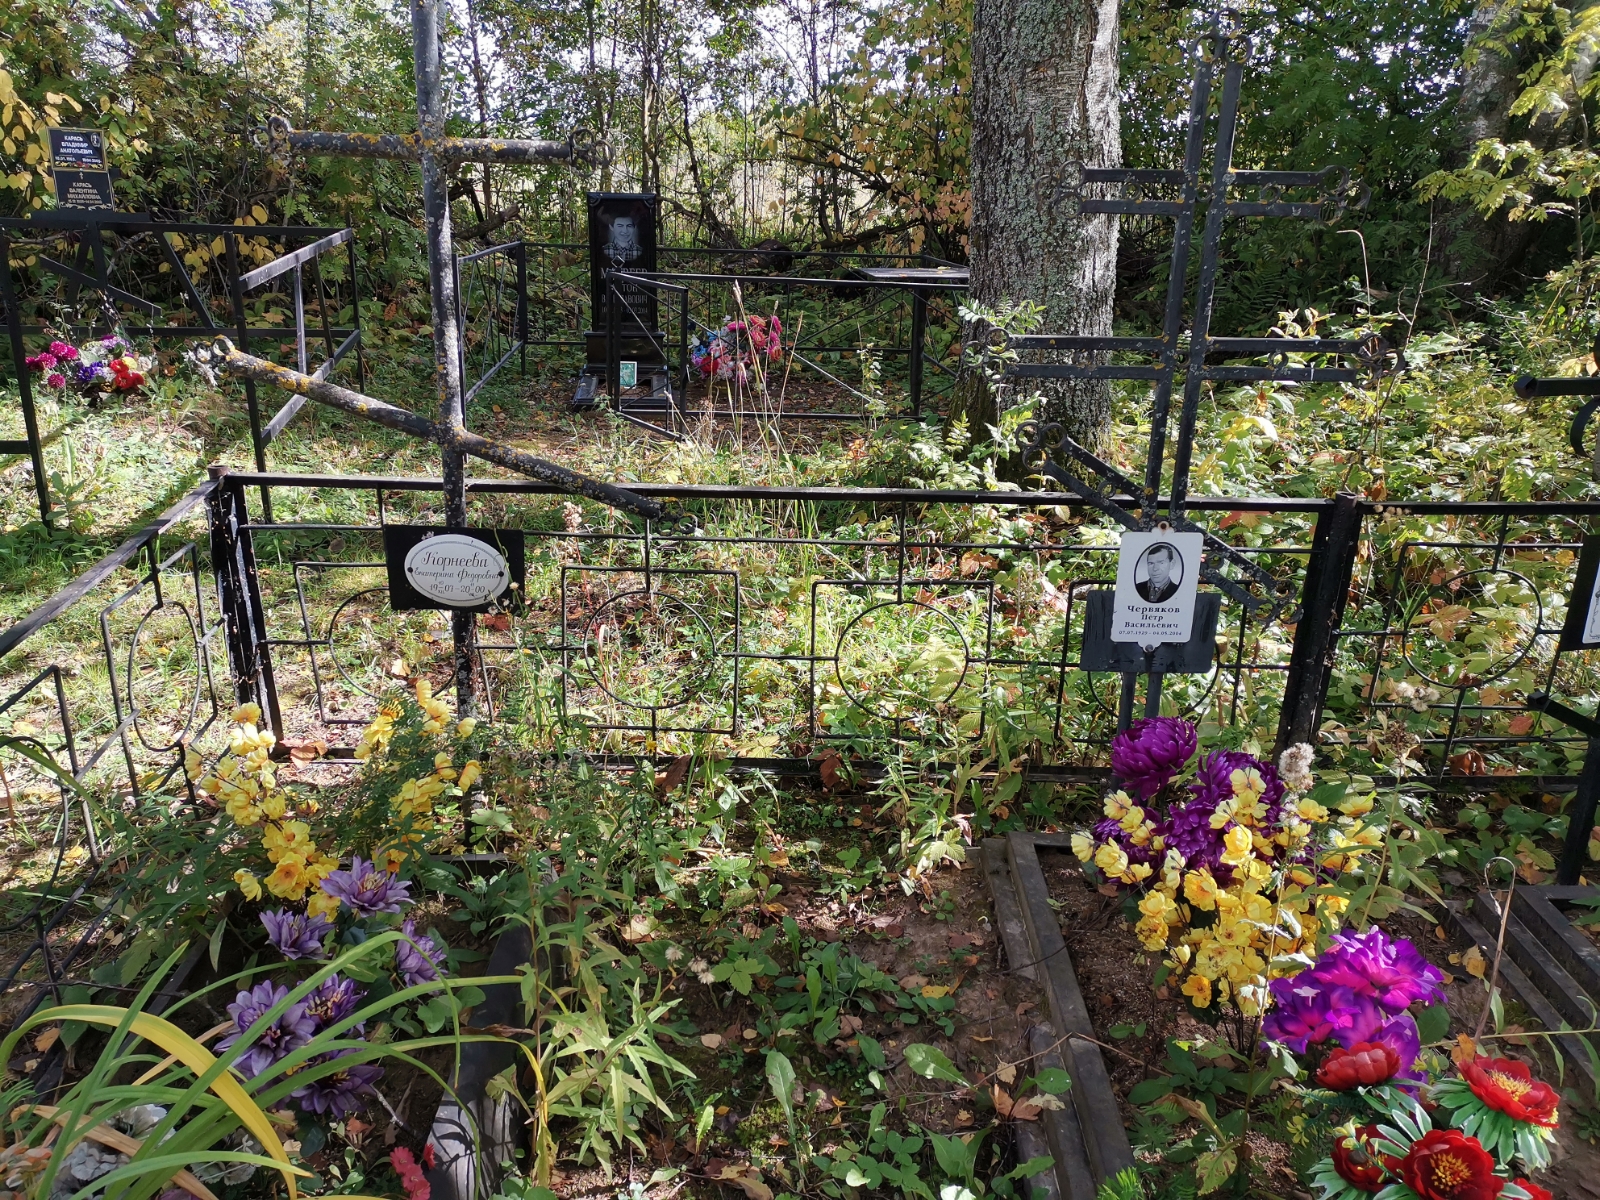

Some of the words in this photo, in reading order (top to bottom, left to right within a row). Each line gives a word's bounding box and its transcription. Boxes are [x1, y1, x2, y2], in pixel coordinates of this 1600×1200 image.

[421, 551, 488, 571] Корнеева
[414, 567, 454, 580] Екатерина
[1127, 605, 1180, 614] Червяков
